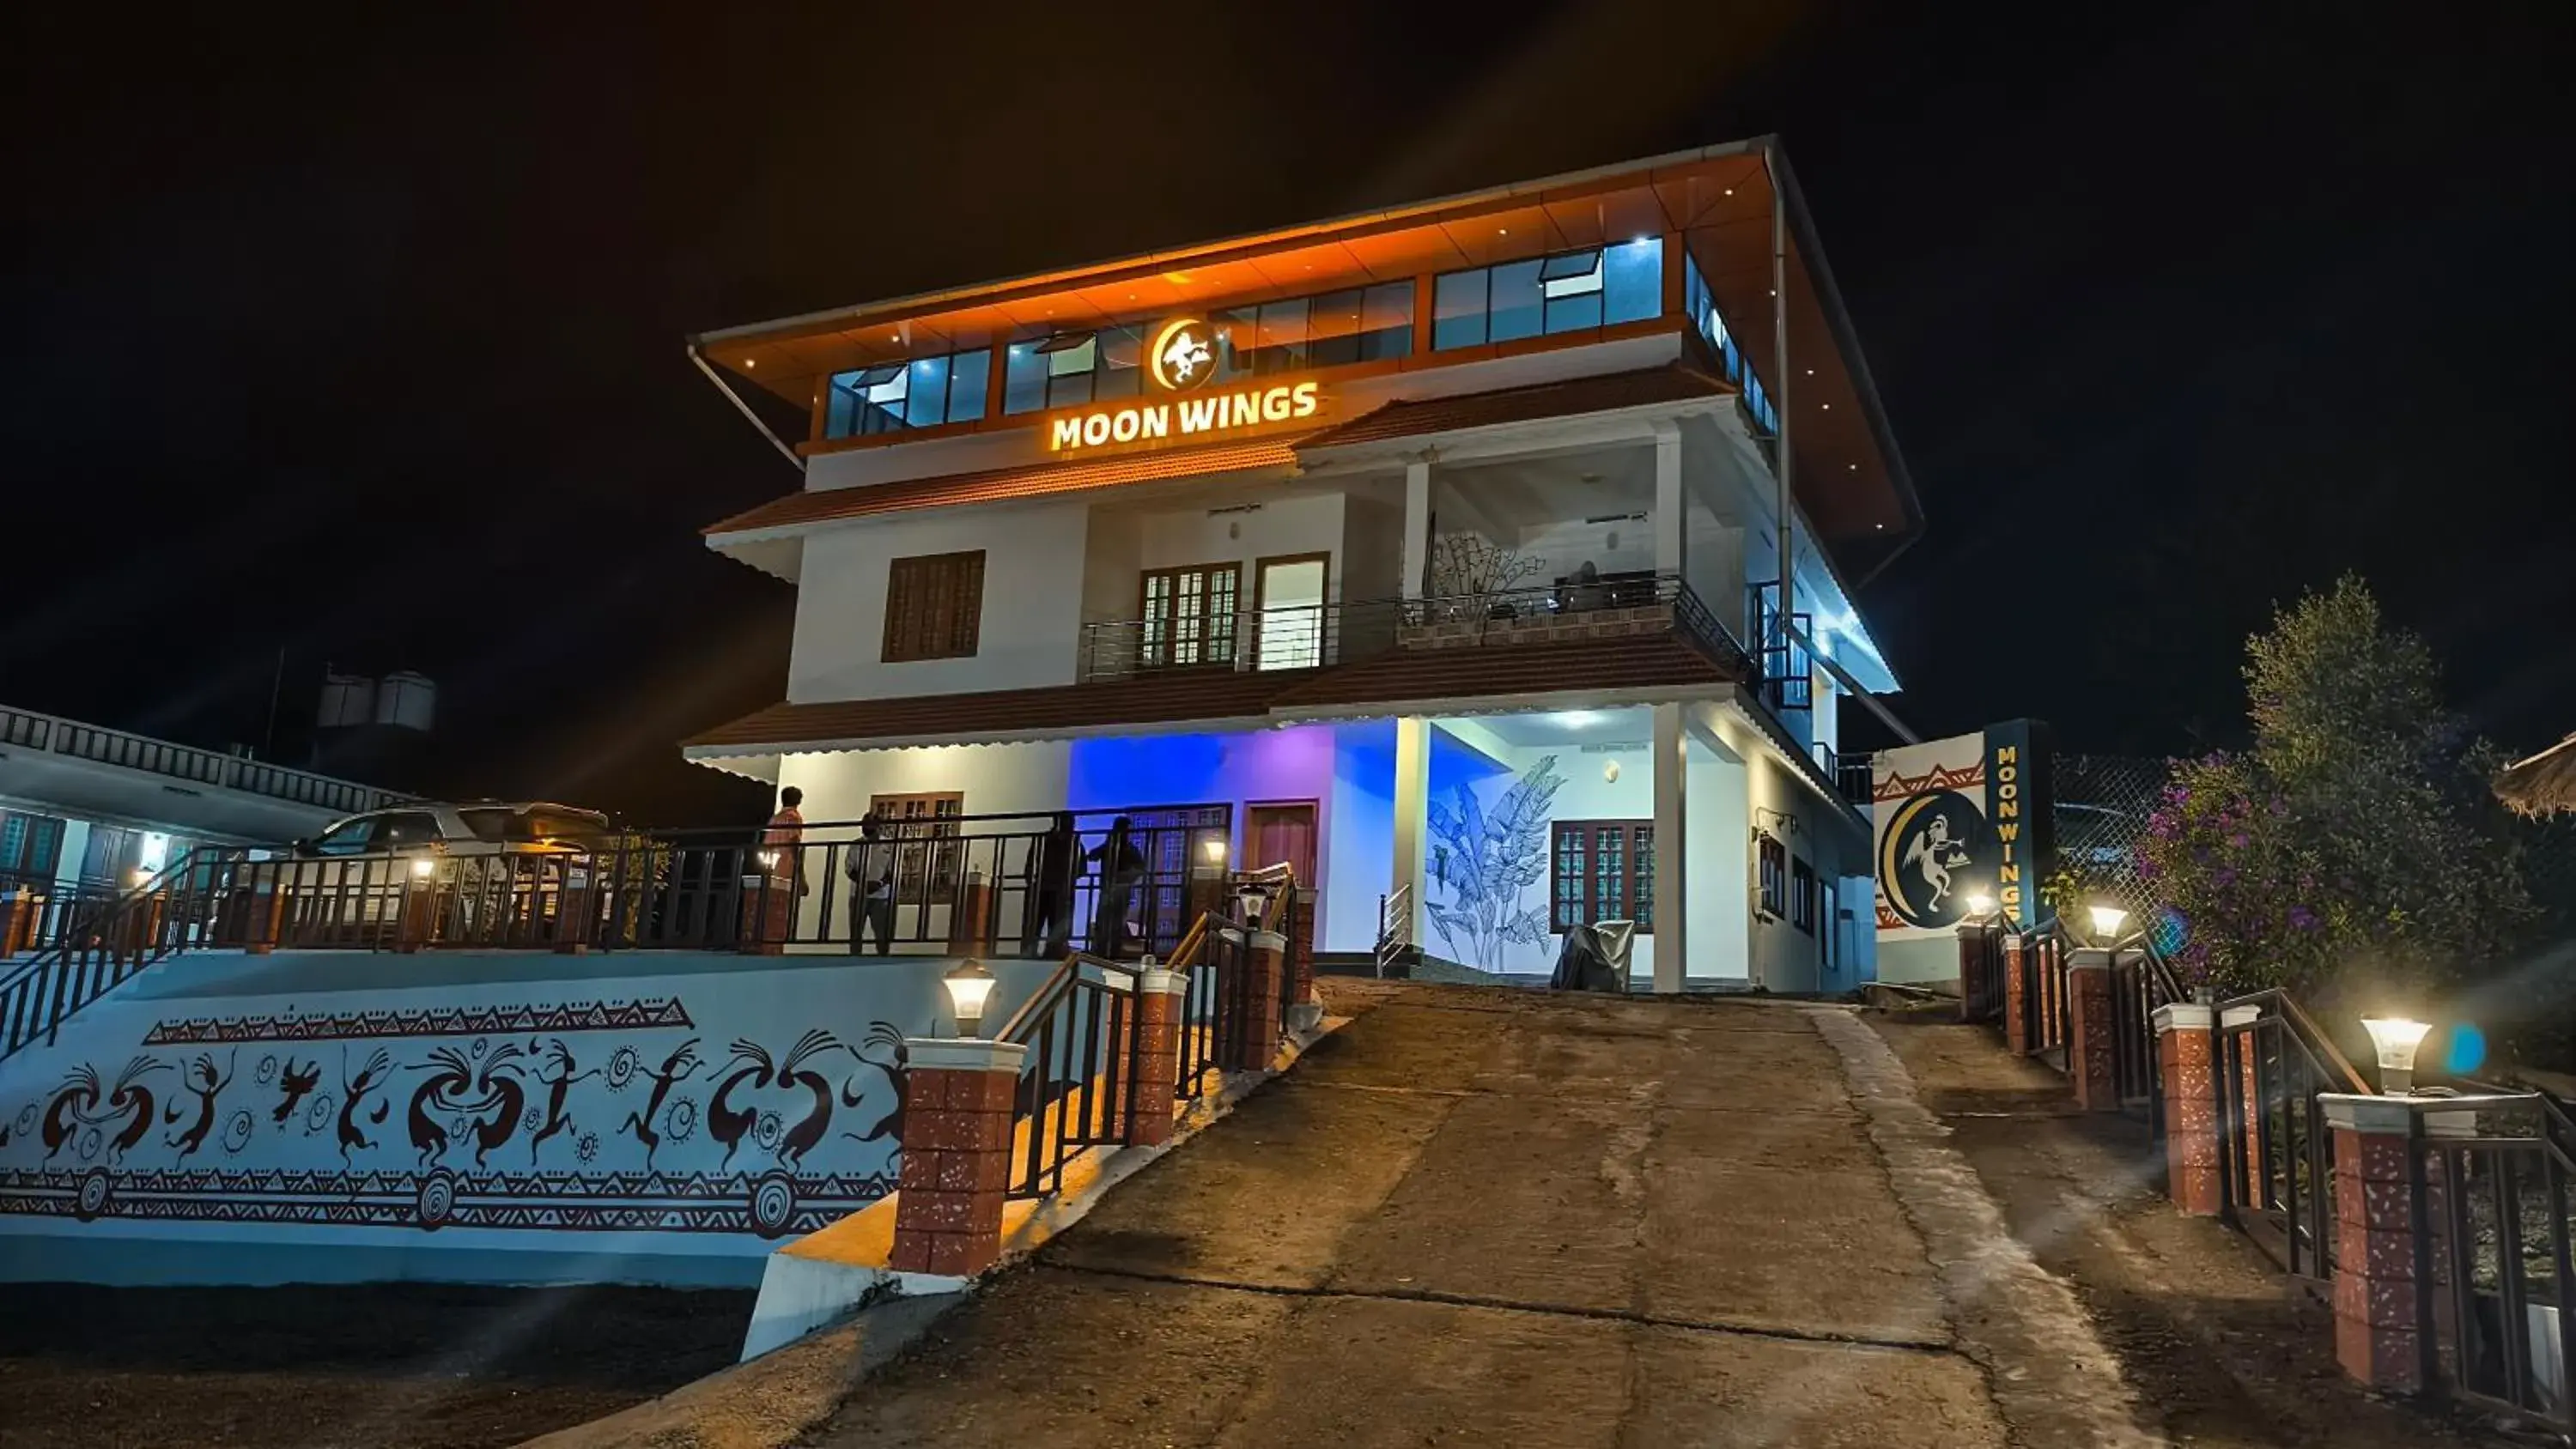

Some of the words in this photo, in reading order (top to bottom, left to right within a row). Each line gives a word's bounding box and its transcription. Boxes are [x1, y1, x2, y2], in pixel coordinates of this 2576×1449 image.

[1051, 405, 1170, 451] MOON
[1179, 381, 1318, 433] WINGS
[1997, 746, 2018, 818] MOON
